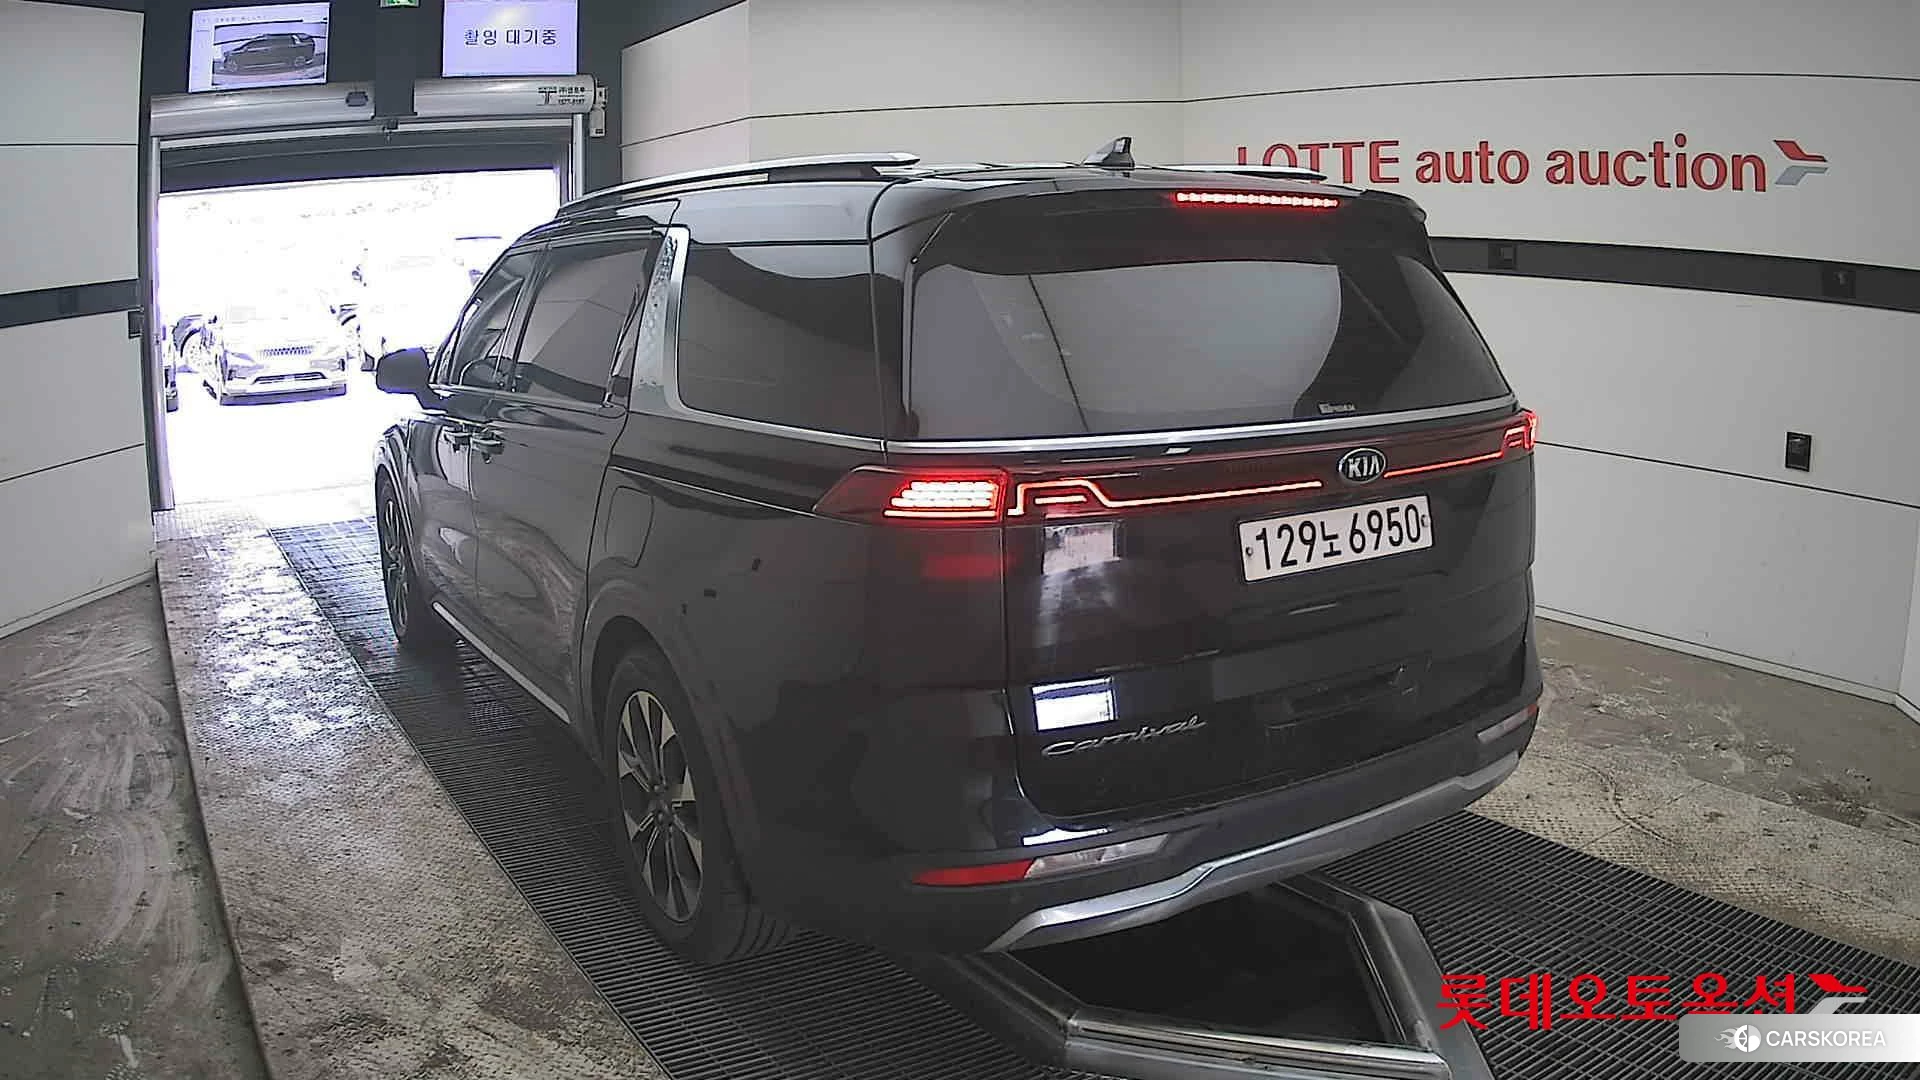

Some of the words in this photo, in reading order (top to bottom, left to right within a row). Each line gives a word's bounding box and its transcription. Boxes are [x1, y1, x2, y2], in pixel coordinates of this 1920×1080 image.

[506, 29, 556, 45] 대기중
[1416, 140, 1530, 185] auto
[1546, 134, 1766, 192] auction
[1348, 455, 1380, 478] KIA
[1255, 520, 1342, 570] 129노
[1350, 503, 1421, 554] 6950
[1041, 715, 1207, 757] Carnival
